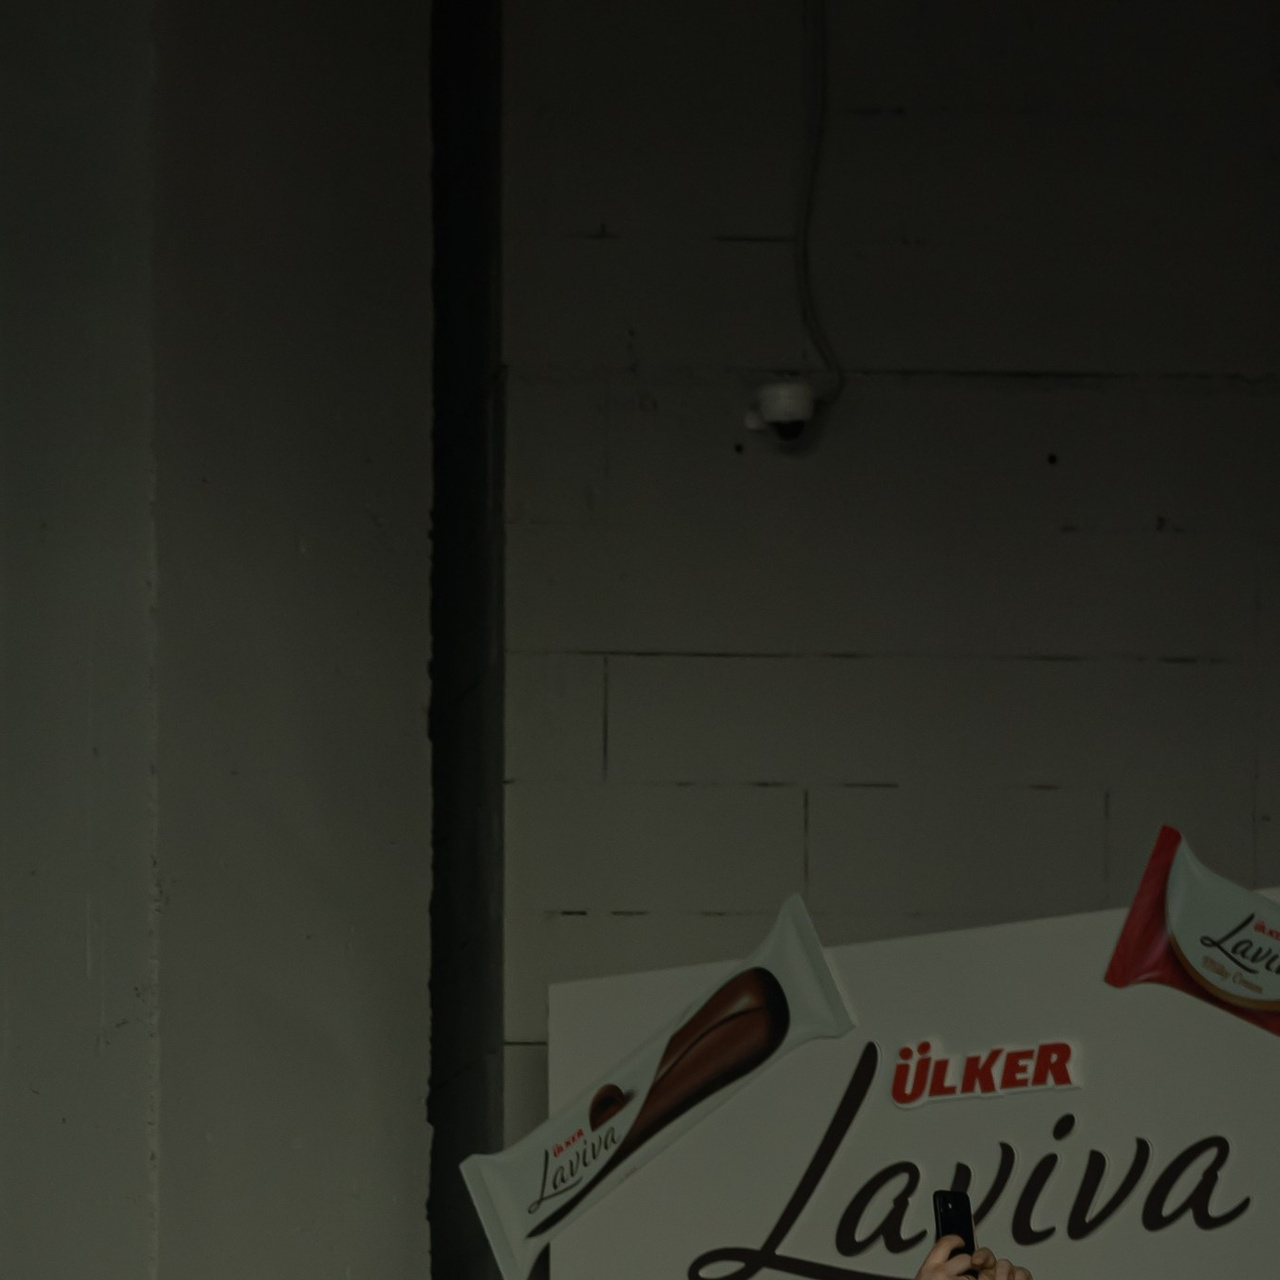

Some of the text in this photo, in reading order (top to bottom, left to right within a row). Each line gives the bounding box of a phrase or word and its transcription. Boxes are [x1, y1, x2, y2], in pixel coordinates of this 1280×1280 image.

[1200, 912, 1280, 978] Lavi
[892, 1042, 1072, 1104] ÜLKER
[528, 1126, 617, 1214] Laviva
